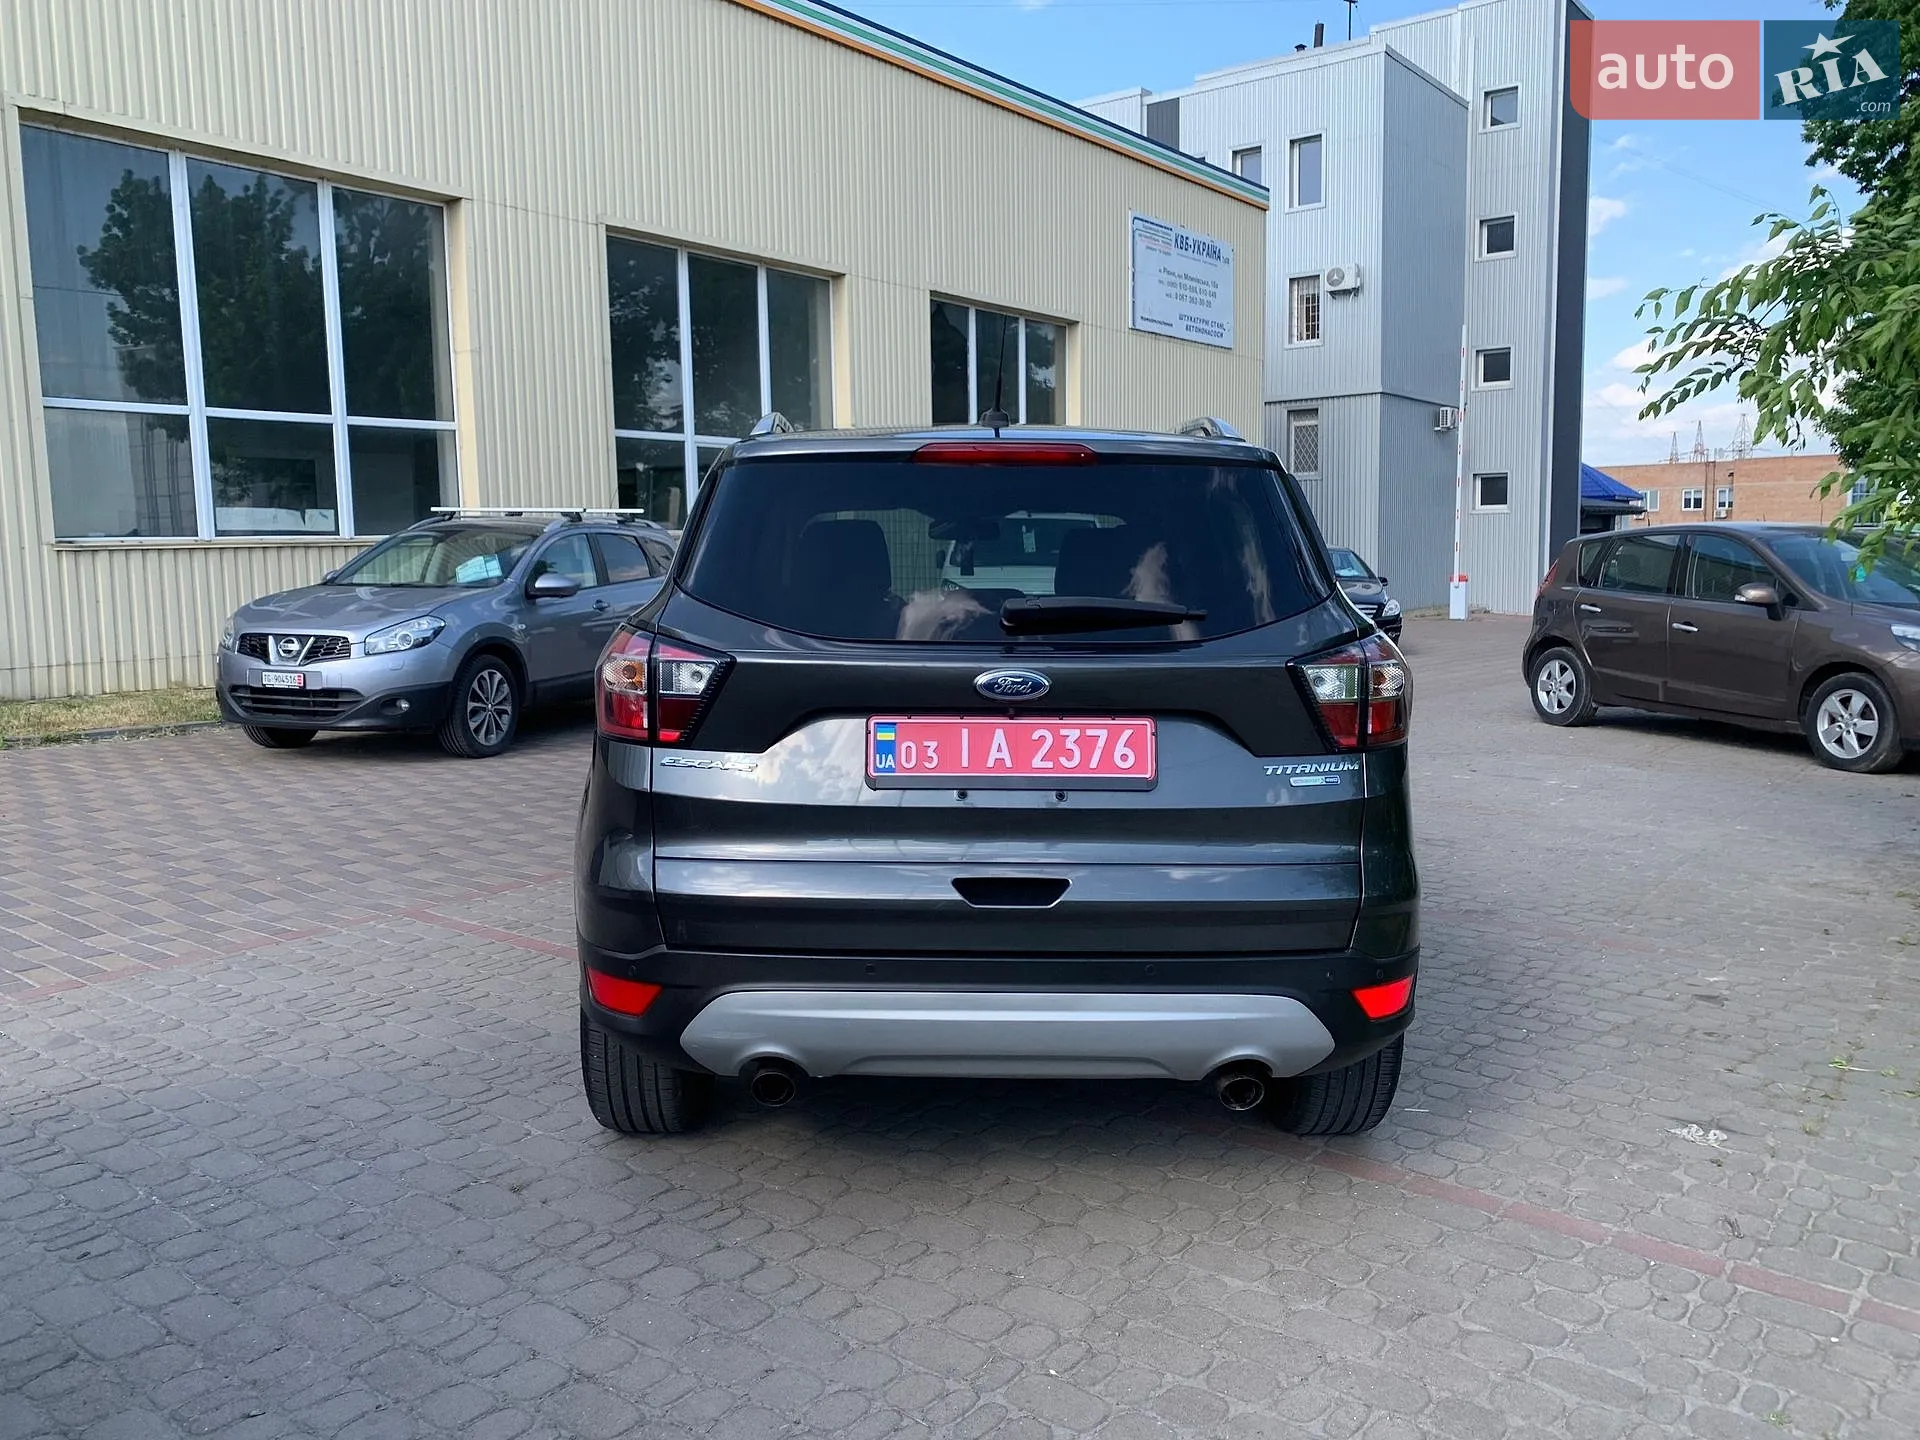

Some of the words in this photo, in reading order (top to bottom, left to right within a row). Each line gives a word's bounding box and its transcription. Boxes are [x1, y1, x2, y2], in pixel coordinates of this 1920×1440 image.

[994, 677, 1032, 693] Ford
[876, 754, 895, 768] UA
[901, 741, 939, 769] 03
[1031, 729, 1136, 770] 2376
[1264, 761, 1360, 775] TITANIUM
